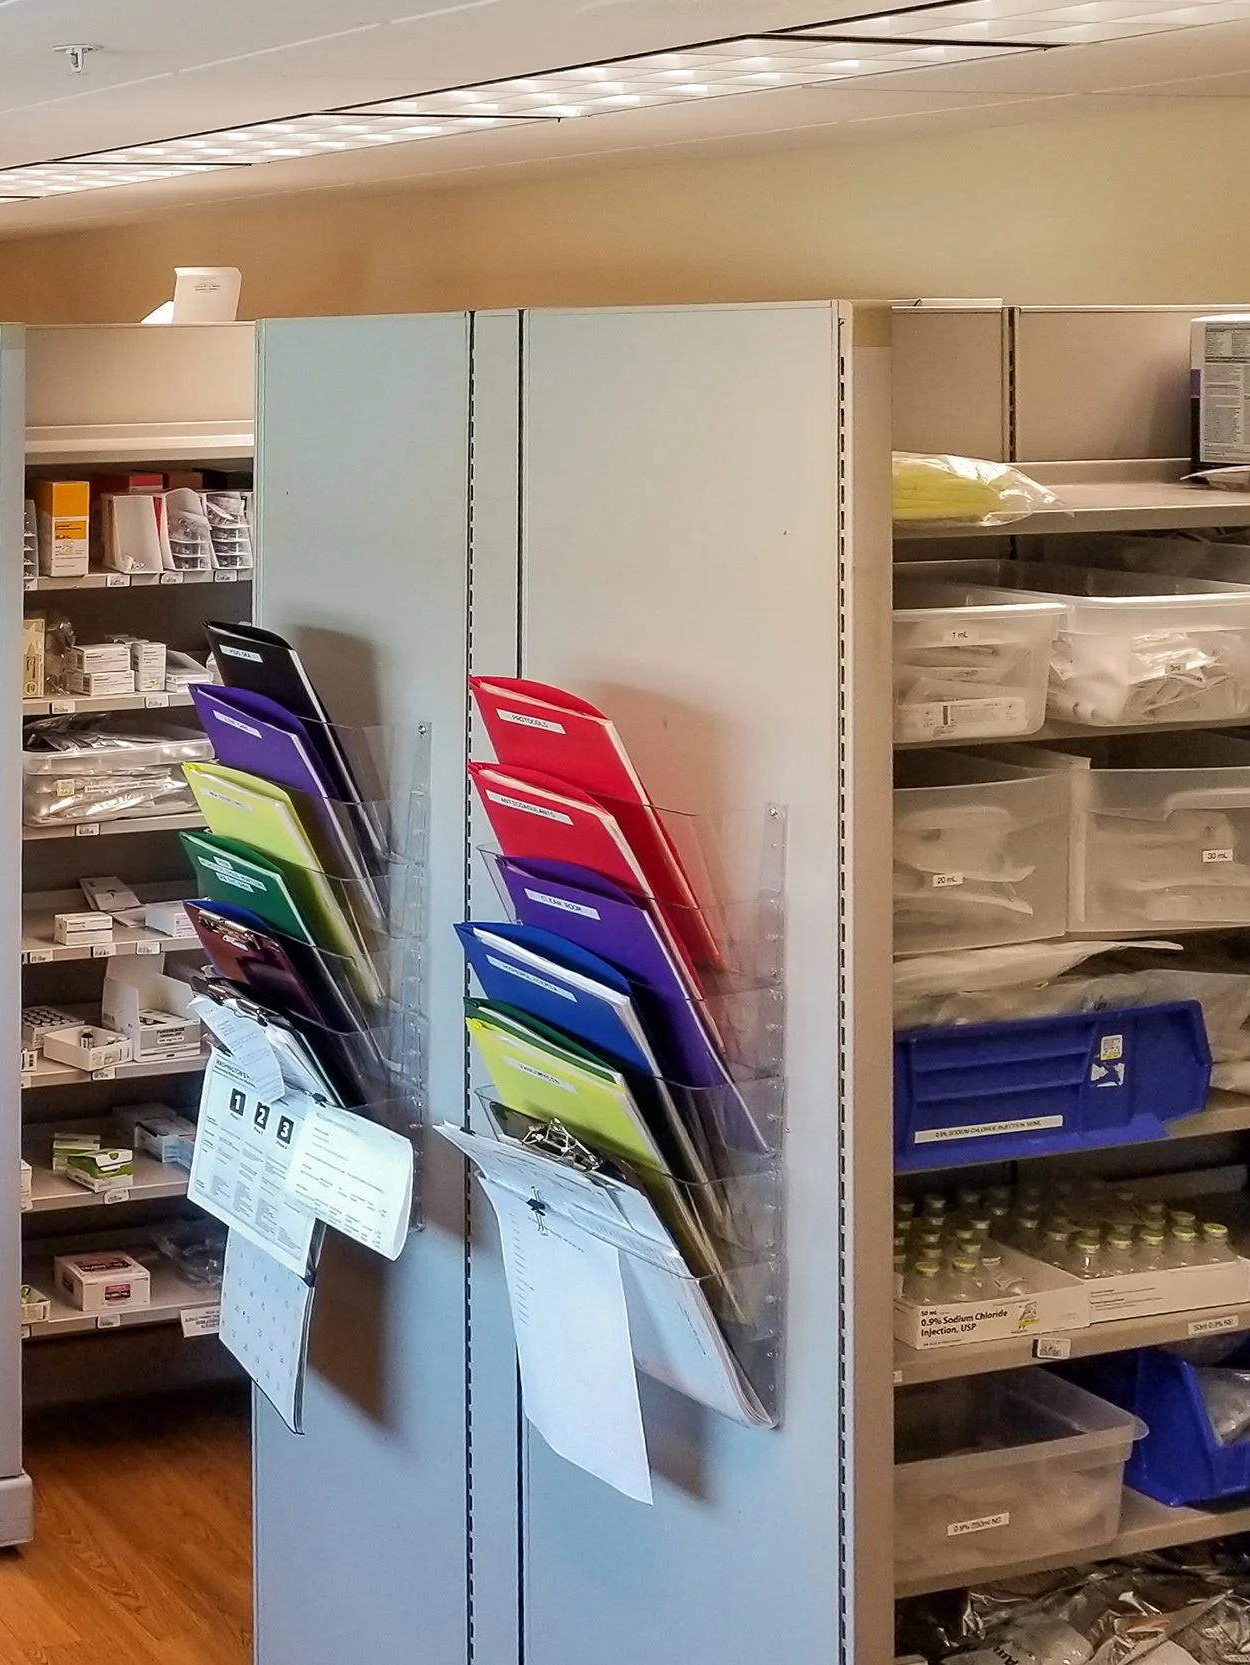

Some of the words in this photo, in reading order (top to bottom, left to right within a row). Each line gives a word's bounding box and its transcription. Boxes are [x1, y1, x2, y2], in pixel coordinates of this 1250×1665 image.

[511, 714, 549, 728] PROTOCOLS
[540, 895, 562, 906] CLEAN
[564, 902, 583, 913] ROOM
[234, 1094, 241, 1111] 1
[258, 1107, 266, 1124] 2
[280, 1121, 289, 1138] 3
[920, 1316, 942, 1327] 0.9%
[942, 1313, 974, 1325] Sodium
[975, 1309, 1009, 1321] Chloride
[920, 1326, 959, 1338] Injection,
[960, 1322, 977, 1333] USP
